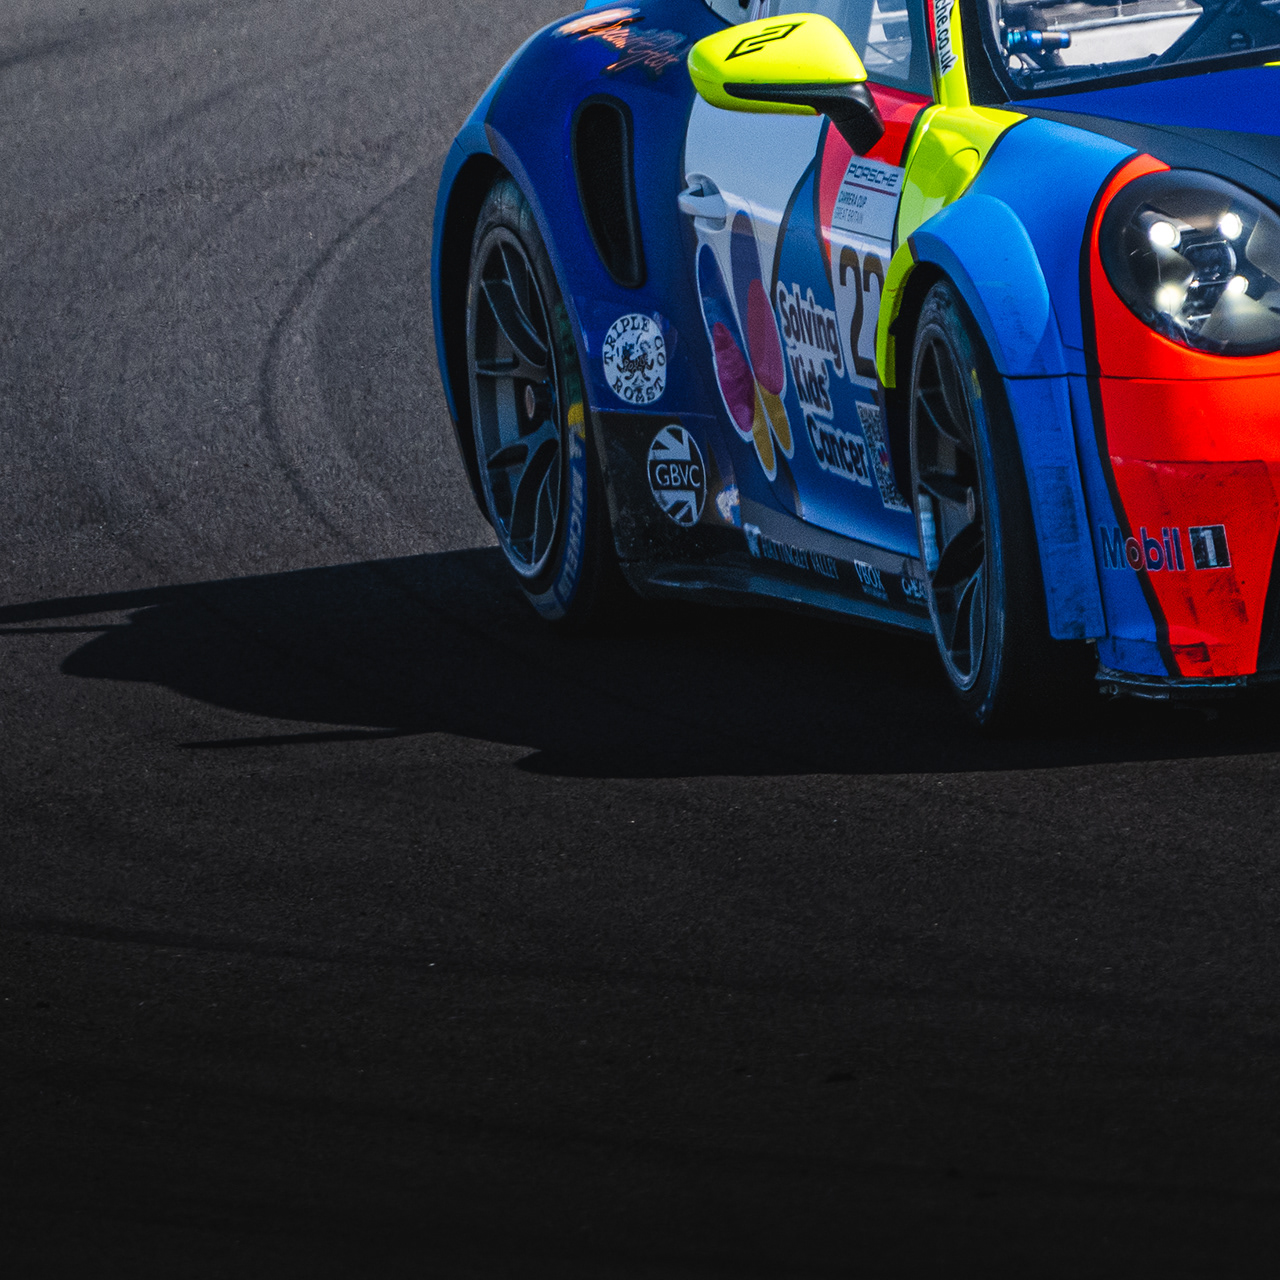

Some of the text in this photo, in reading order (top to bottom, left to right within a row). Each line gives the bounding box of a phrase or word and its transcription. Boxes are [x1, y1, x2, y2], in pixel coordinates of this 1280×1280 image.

[846, 162, 899, 188] PORSCHE
[604, 316, 650, 366] TRIPLE
[778, 288, 843, 371] Solving
[806, 412, 869, 479] Cancer
[655, 463, 701, 489] GBVC
[1099, 524, 1186, 572] Mobil
